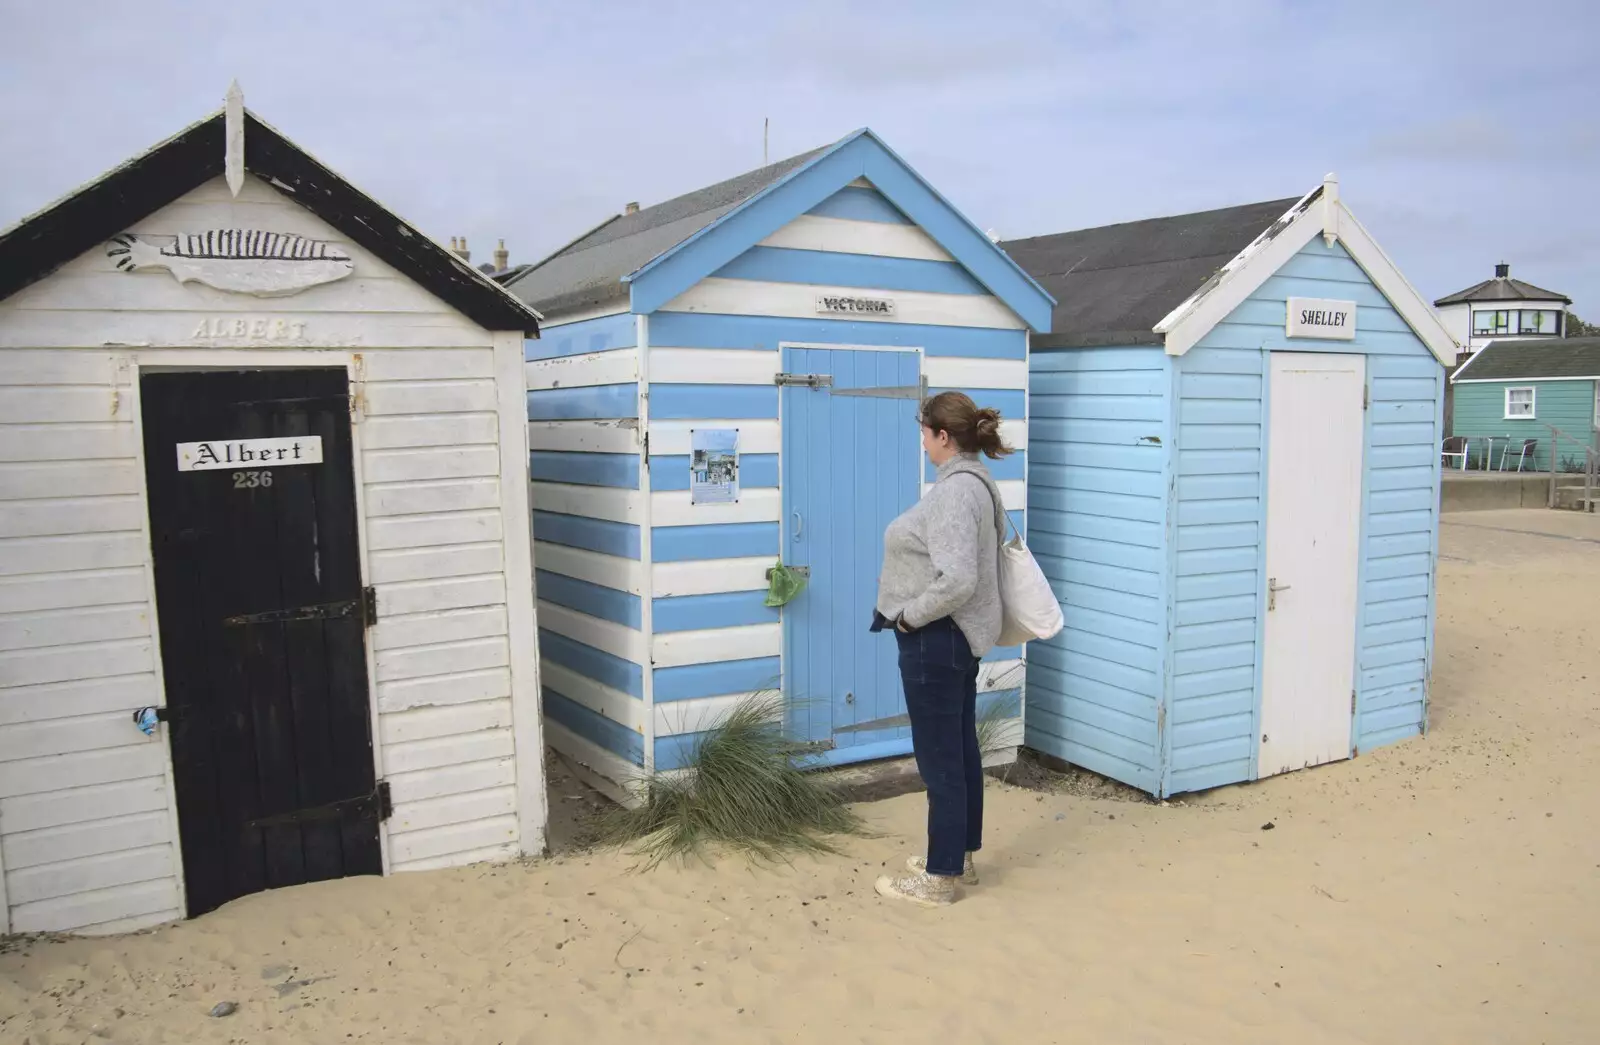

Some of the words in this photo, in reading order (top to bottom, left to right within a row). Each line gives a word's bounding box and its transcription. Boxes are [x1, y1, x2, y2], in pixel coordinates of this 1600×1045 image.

[823, 297, 888, 312] VICTORIA
[1300, 309, 1347, 327] SHELLEY
[191, 318, 307, 340] ALBERT
[192, 442, 301, 469] Albert
[232, 470, 273, 489] 236
